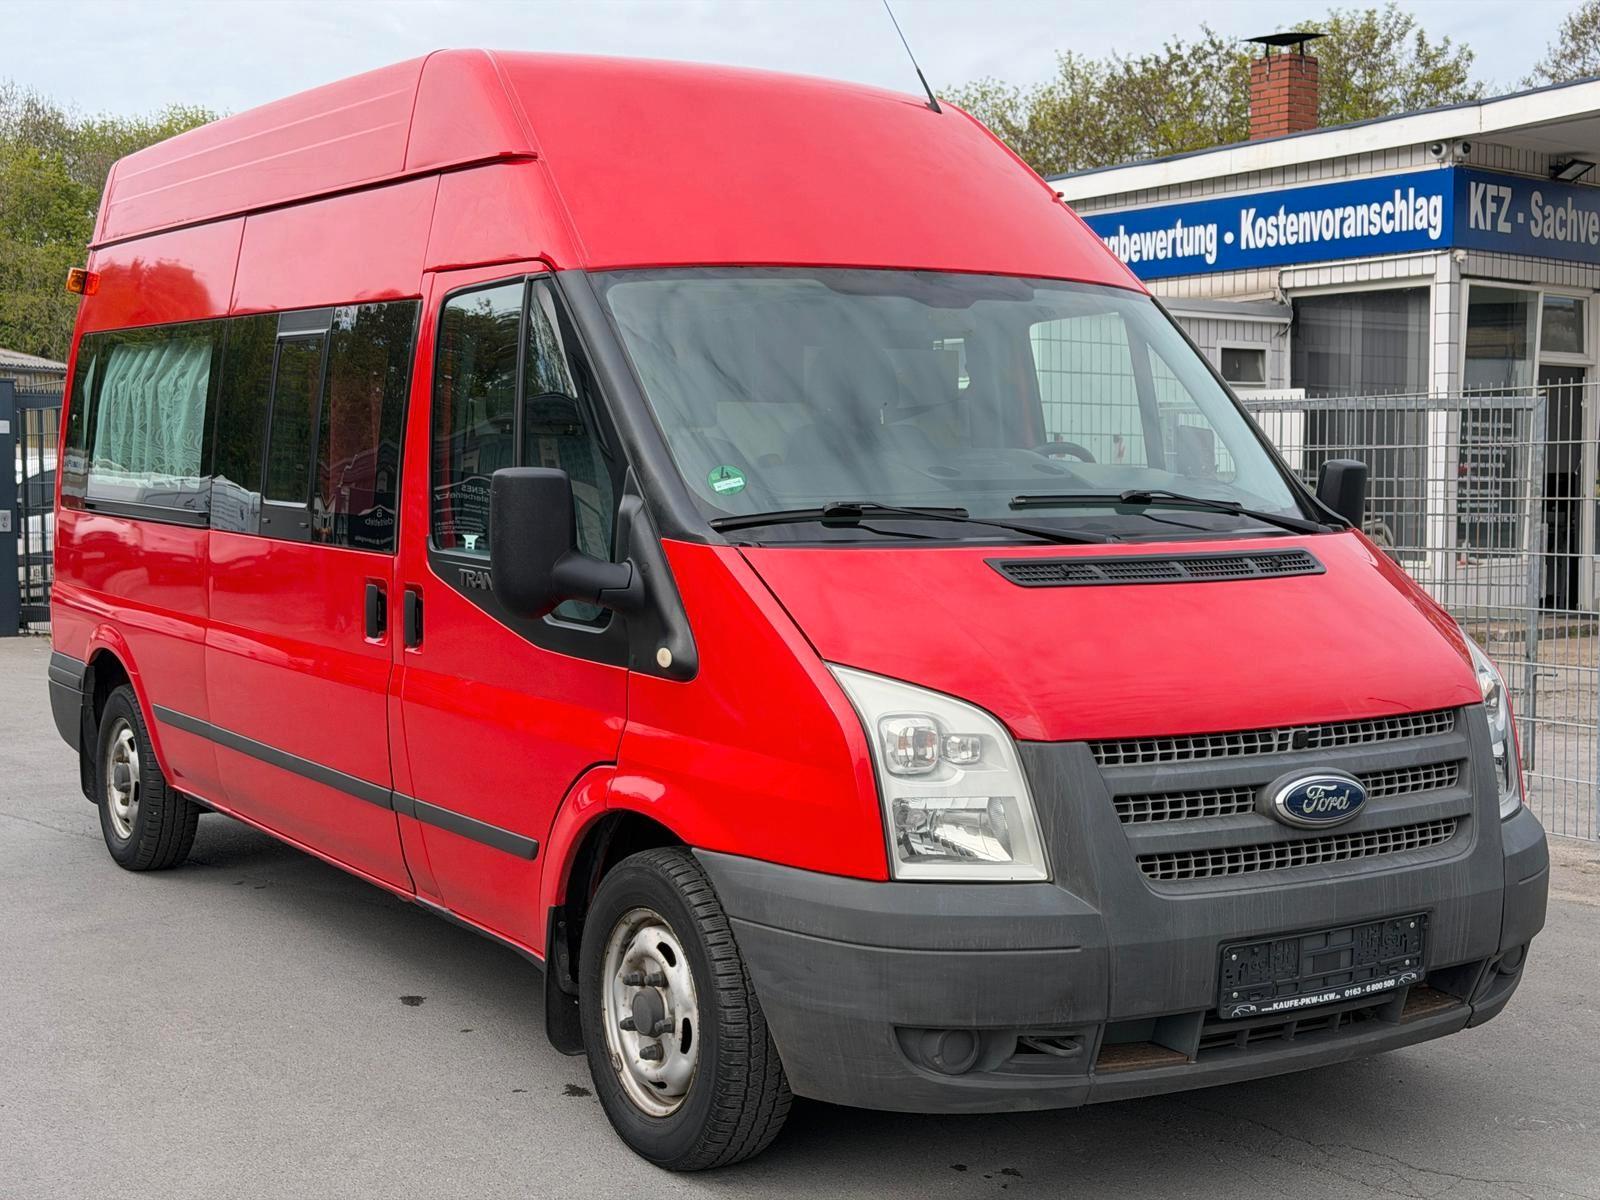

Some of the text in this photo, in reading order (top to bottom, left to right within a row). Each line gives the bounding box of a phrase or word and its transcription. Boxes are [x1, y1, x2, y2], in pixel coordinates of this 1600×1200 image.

[1103, 187, 1443, 265] bewertung Kostenvoranschlag
[1470, 181, 1512, 234] KFZ
[1530, 190, 1600, 245] Sachve
[1303, 784, 1350, 813] Ford
[1345, 987, 1361, 997] 0163
